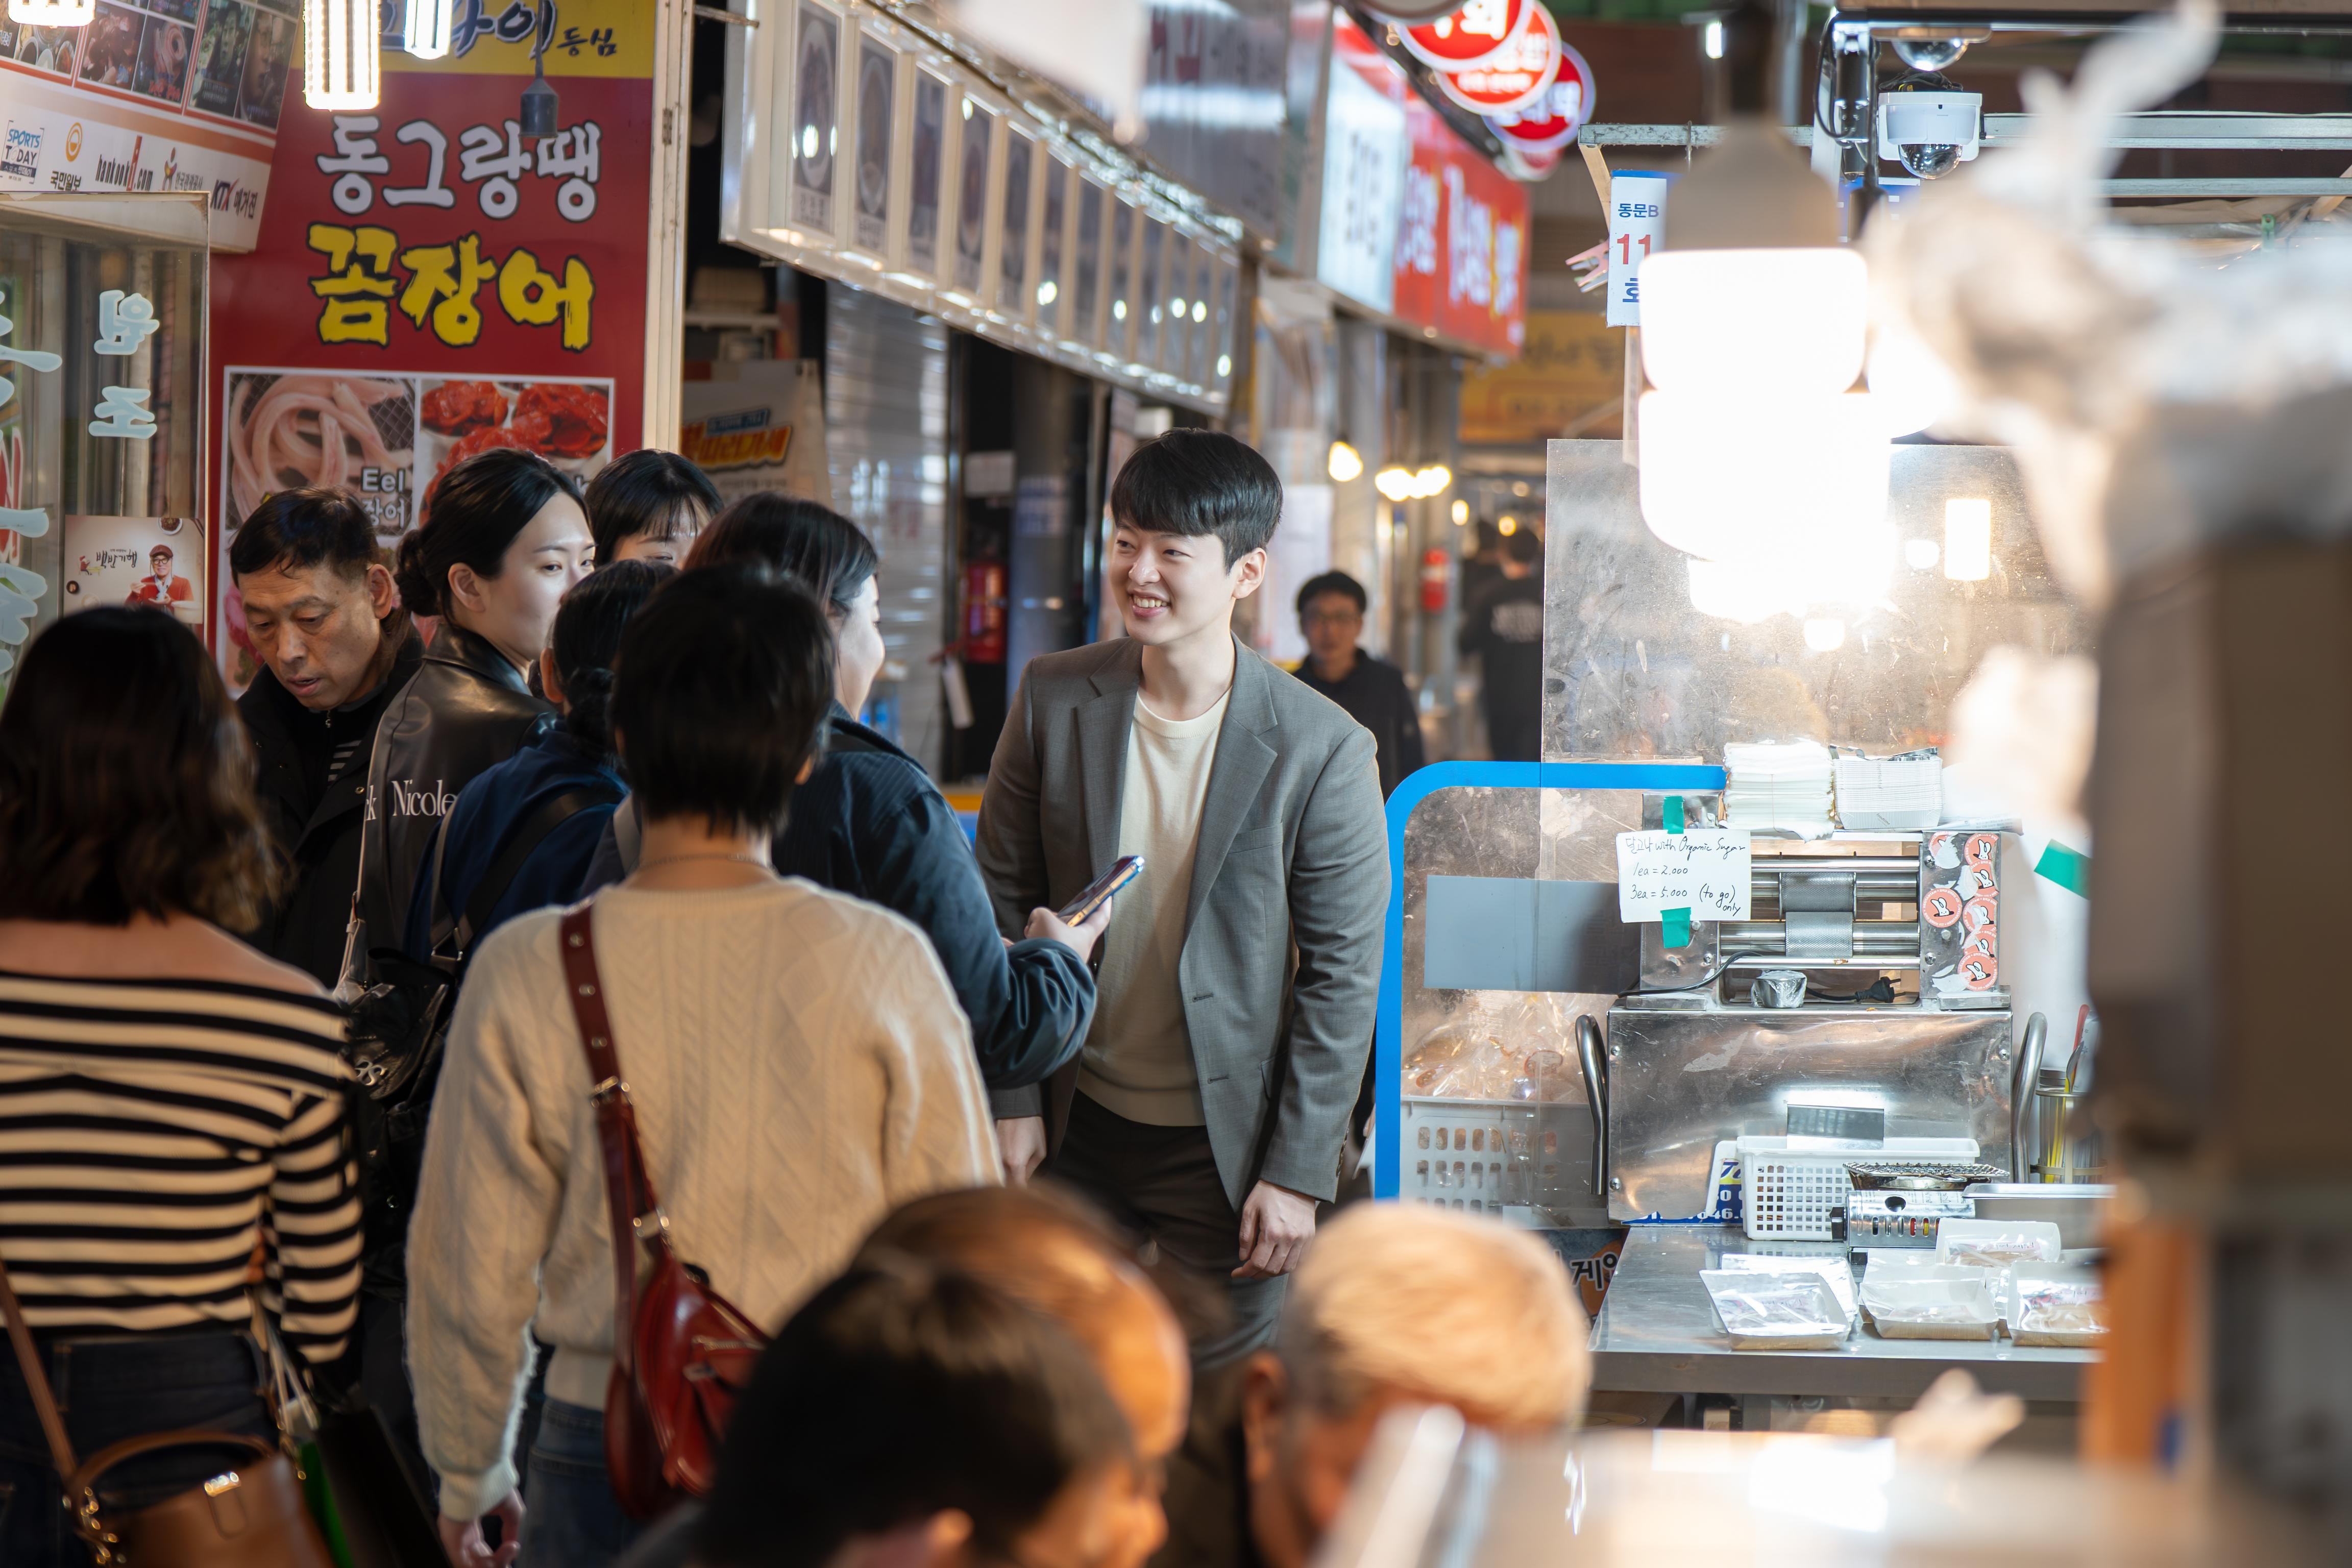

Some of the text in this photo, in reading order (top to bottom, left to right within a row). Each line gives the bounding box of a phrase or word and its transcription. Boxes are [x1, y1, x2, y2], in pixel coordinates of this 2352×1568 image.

[7, 129, 41, 149] SPORTS
[5, 145, 37, 166] TODAY
[315, 115, 603, 222] 동그랑땡
[51, 170, 82, 191] 국민일보
[210, 178, 239, 211] KTX
[1618, 203, 1659, 218] 동문B
[308, 223, 595, 353] 꼼장어
[361, 467, 405, 493] Eel
[96, 549, 137, 569] 백반기행
[1625, 836, 1746, 861] 달고나 with Organic Sugar
[1633, 863, 1649, 876] 1ea
[1631, 884, 1648, 899] 3ea
[1723, 903, 1741, 917] only
